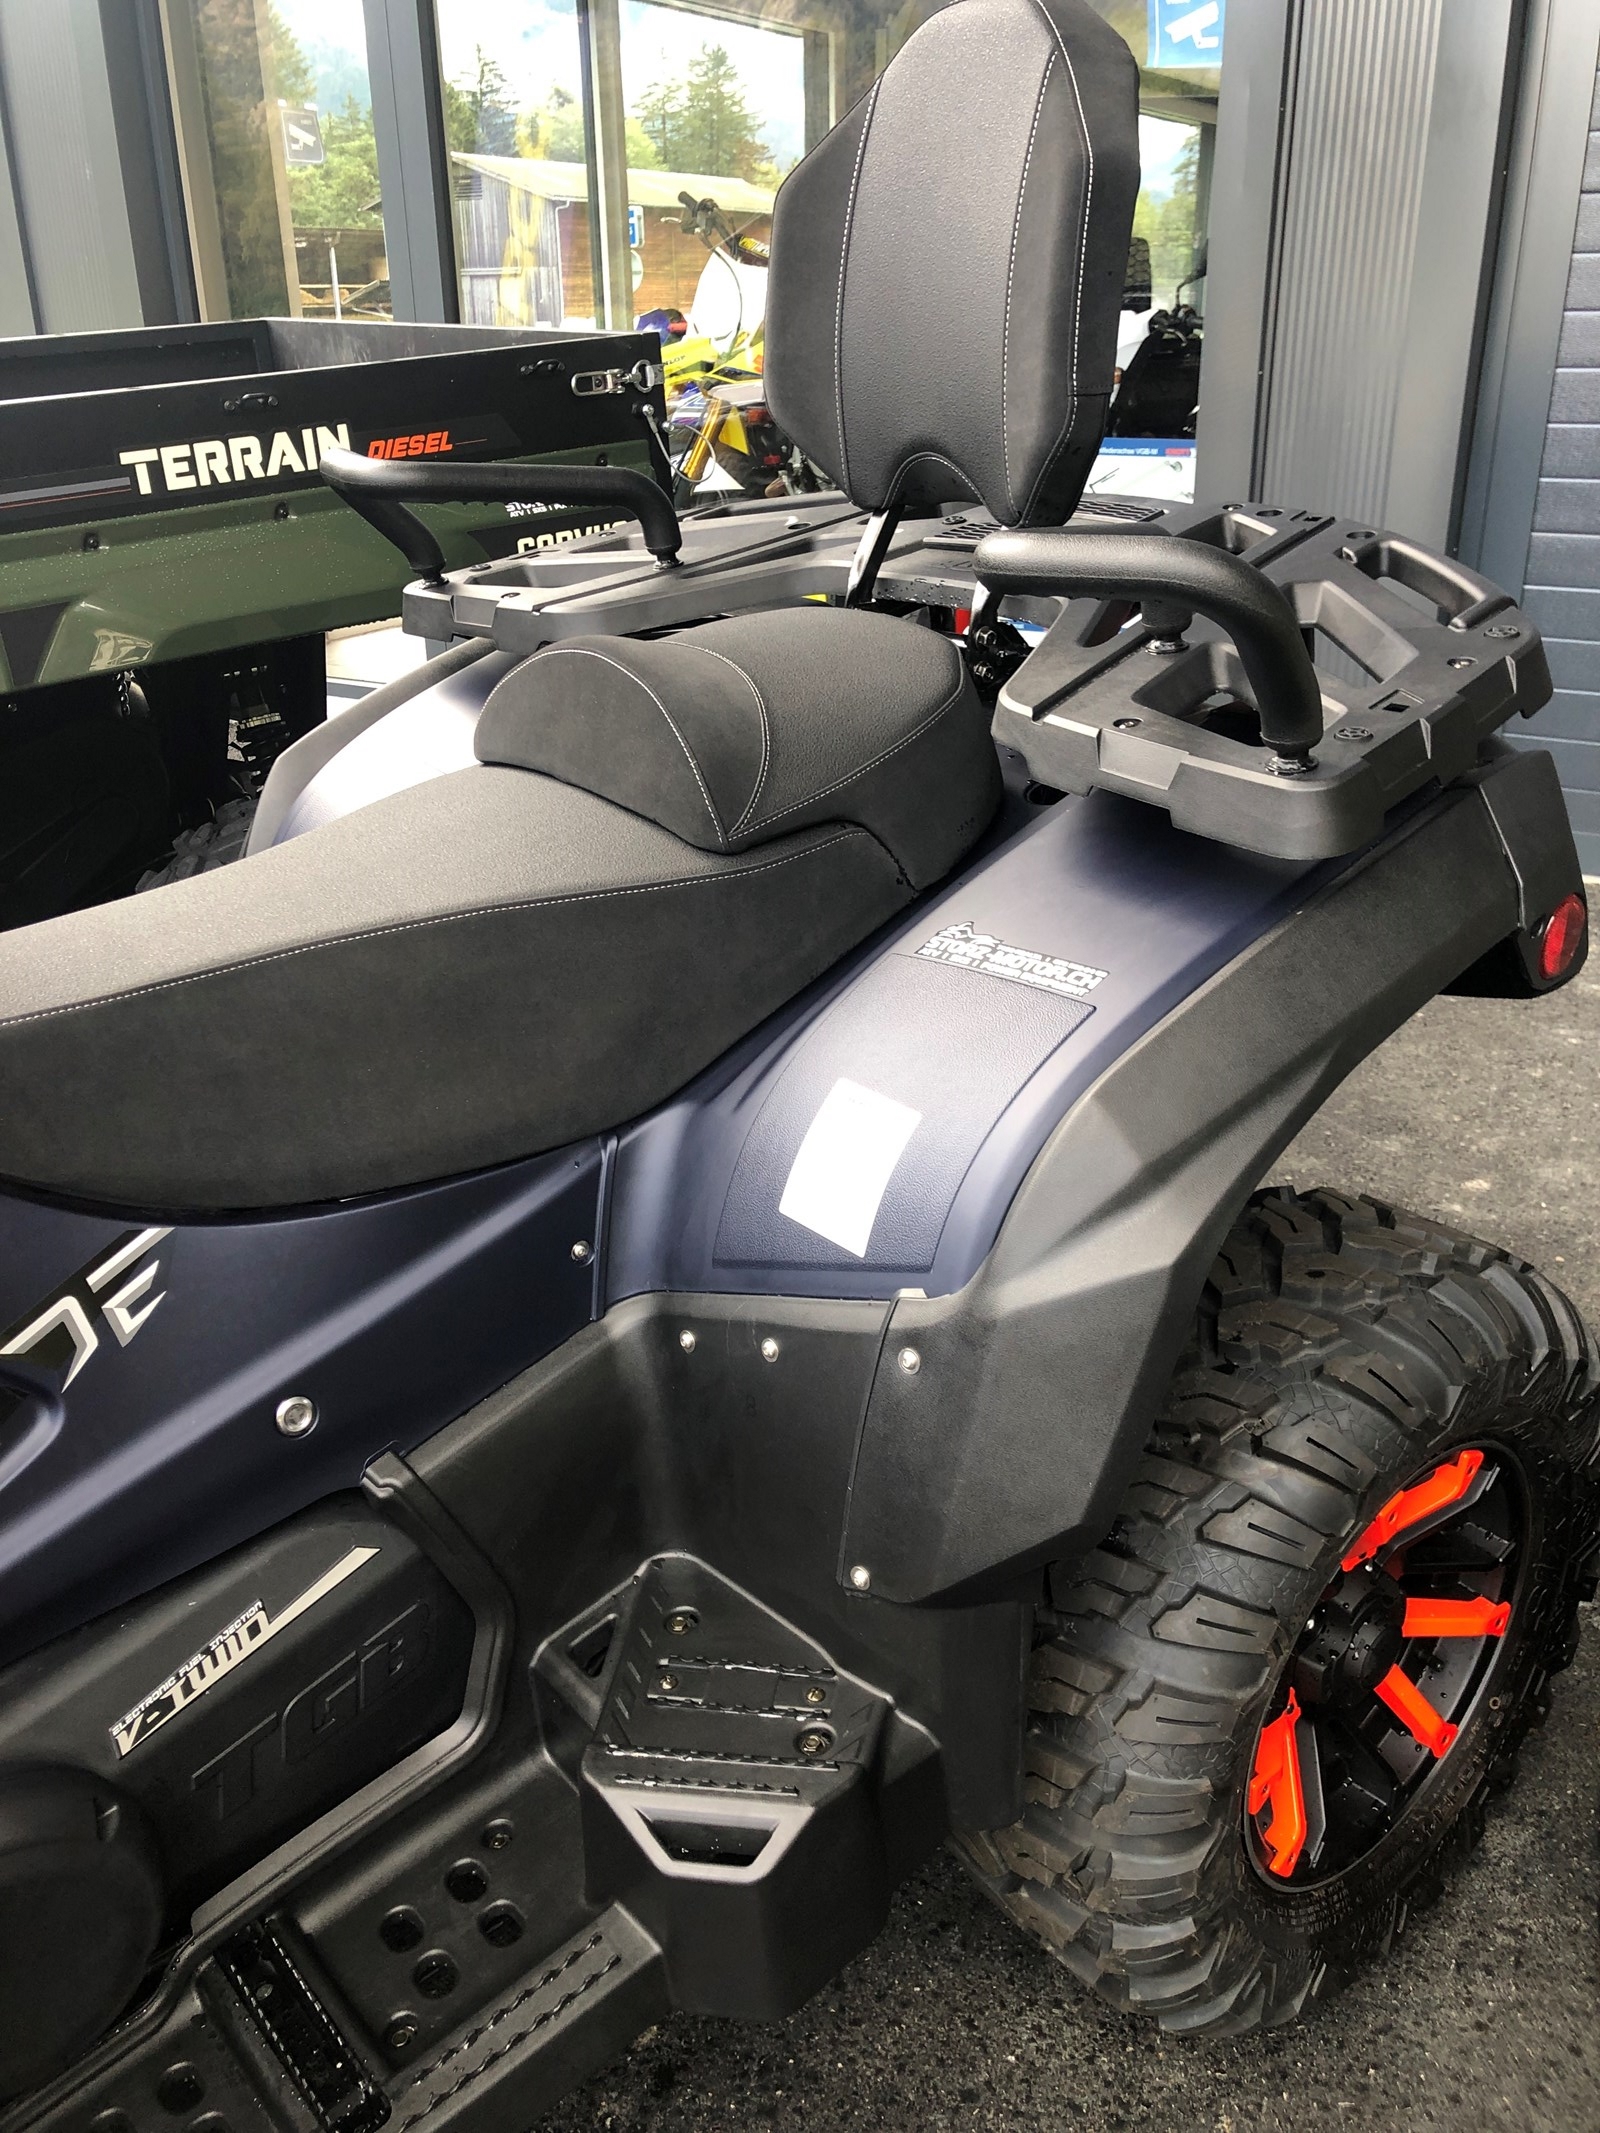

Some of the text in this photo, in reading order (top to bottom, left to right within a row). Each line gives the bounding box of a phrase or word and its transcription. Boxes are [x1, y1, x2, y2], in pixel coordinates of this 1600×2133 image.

[119, 423, 453, 495] TERRAIN DIESEL
[111, 1600, 264, 1737] ELECTRONIC FUEL INJECTION
[191, 1599, 432, 1822] TGB
